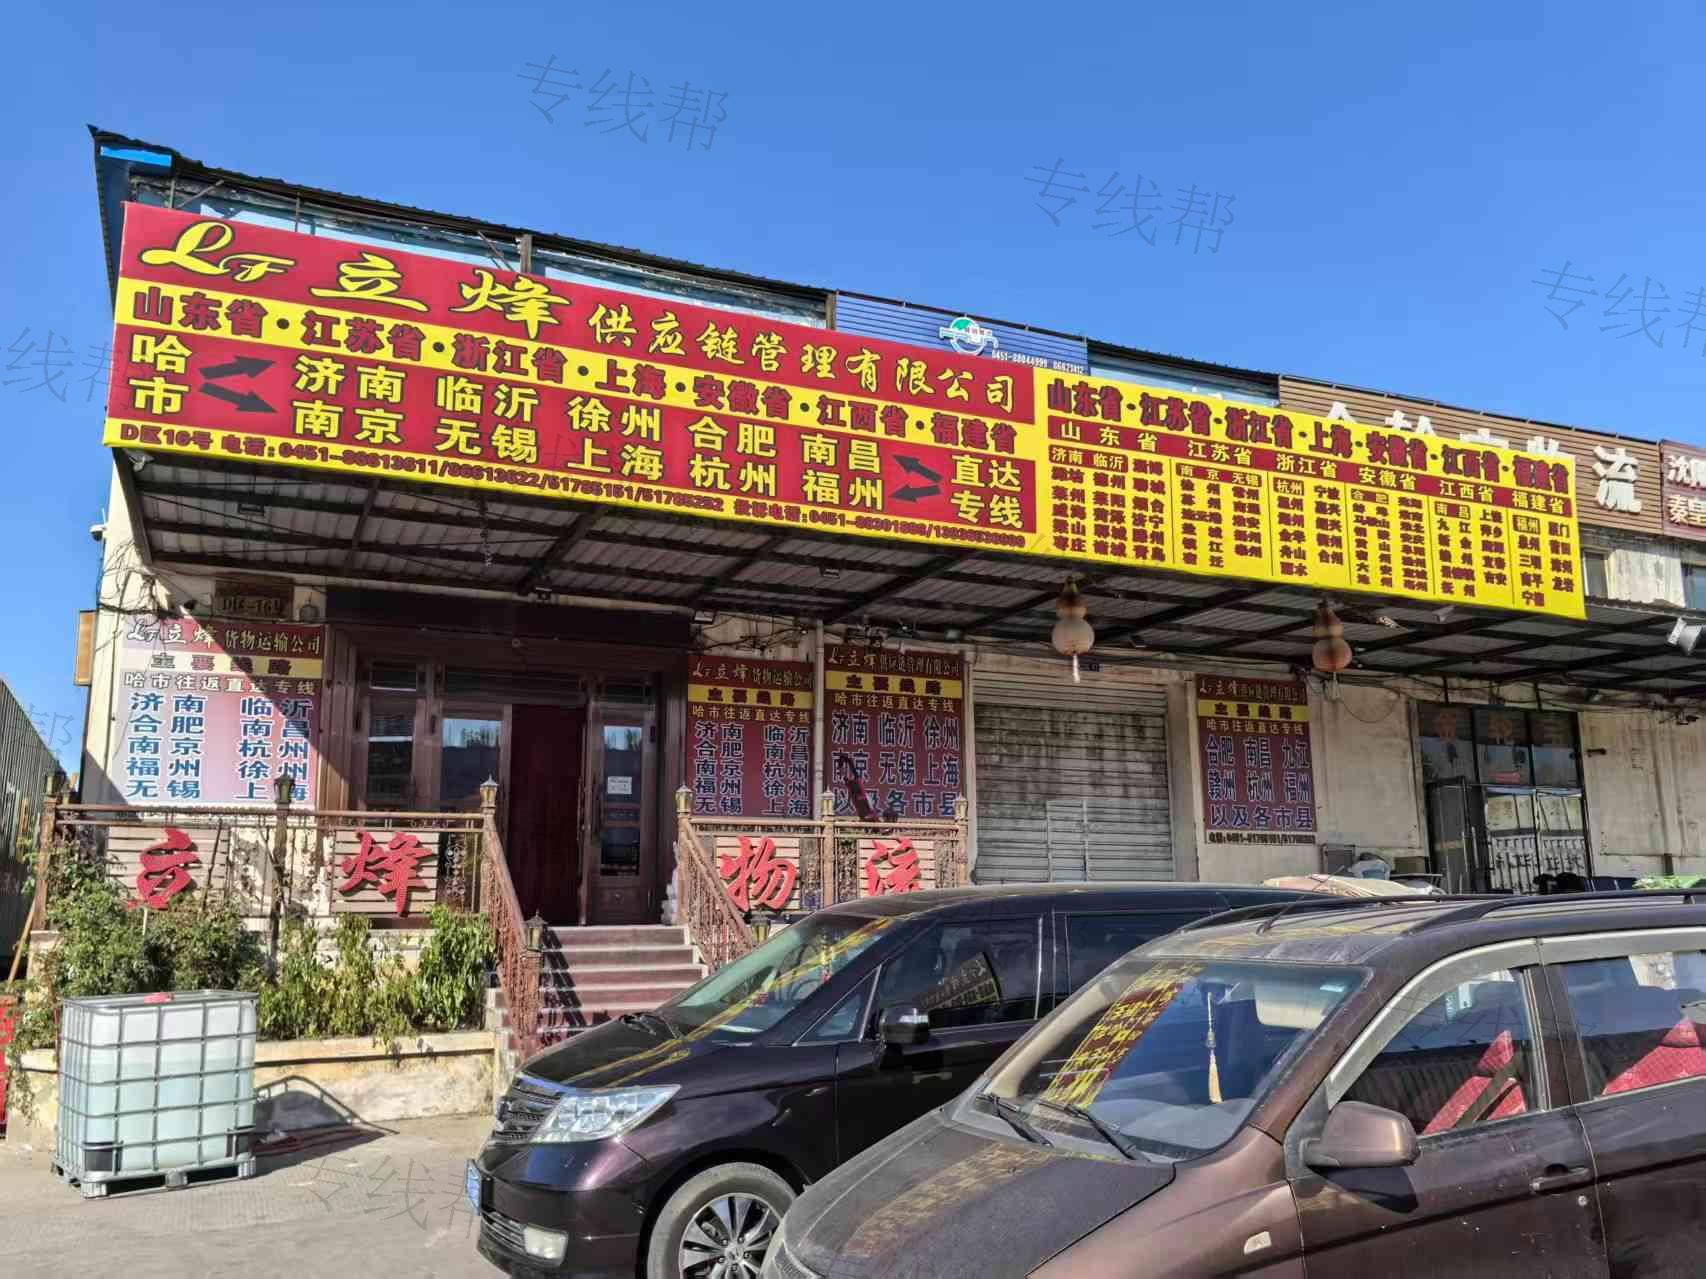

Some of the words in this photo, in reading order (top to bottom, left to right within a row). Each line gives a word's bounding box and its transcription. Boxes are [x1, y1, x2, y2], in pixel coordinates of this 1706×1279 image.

[588, 303, 1015, 413] 供应链管理有限公司
[294, 354, 405, 403] 济南
[437, 375, 538, 423] 临沂
[567, 395, 660, 441] 徐州
[689, 416, 776, 457] 合肥
[801, 433, 880, 473] 南昌
[951, 454, 1022, 493] 直达
[291, 399, 404, 444] 南京
[436, 418, 538, 464] 无锡
[567, 438, 664, 481] 上海
[689, 453, 776, 497] 杭州
[803, 469, 883, 510] 福州
[950, 489, 1024, 529] 专线
[1052, 448, 1083, 464] 济南
[1060, 421, 1158, 453] 山东省
[1188, 440, 1252, 465] 江苏省
[1277, 453, 1337, 479] 浙江省
[1359, 467, 1416, 491] 安徽省
[1440, 480, 1494, 504] 江西省
[1512, 490, 1564, 514] 福建省
[125, 672, 315, 697] 哈市往返直达专线
[130, 693, 207, 714] 济南
[239, 697, 313, 719] 临沂
[129, 714, 204, 734] 合肥
[240, 719, 310, 739] 南昌
[695, 722, 744, 741] 济南
[764, 726, 809, 744] 临沂
[831, 711, 869, 745] 济南
[879, 712, 914, 746] 临沂
[924, 717, 959, 750] 徐州
[128, 736, 204, 756] 南京
[238, 739, 308, 759] 杭州
[695, 740, 744, 758] 合肥
[764, 744, 809, 762] 南昌
[126, 757, 200, 777] 福州
[238, 762, 307, 781] 徐州
[695, 759, 744, 777] 南京
[764, 763, 809, 779] 杭州
[879, 752, 915, 785] 无锡
[924, 752, 959, 786] 上海
[126, 780, 200, 799] 无锡
[695, 777, 742, 795] 福州
[764, 780, 809, 797] 徐州
[695, 797, 742, 815] 无锡
[763, 799, 809, 816] 上海
[1211, 804, 1313, 829] 以及各市县
[720, 835, 798, 912] 物
